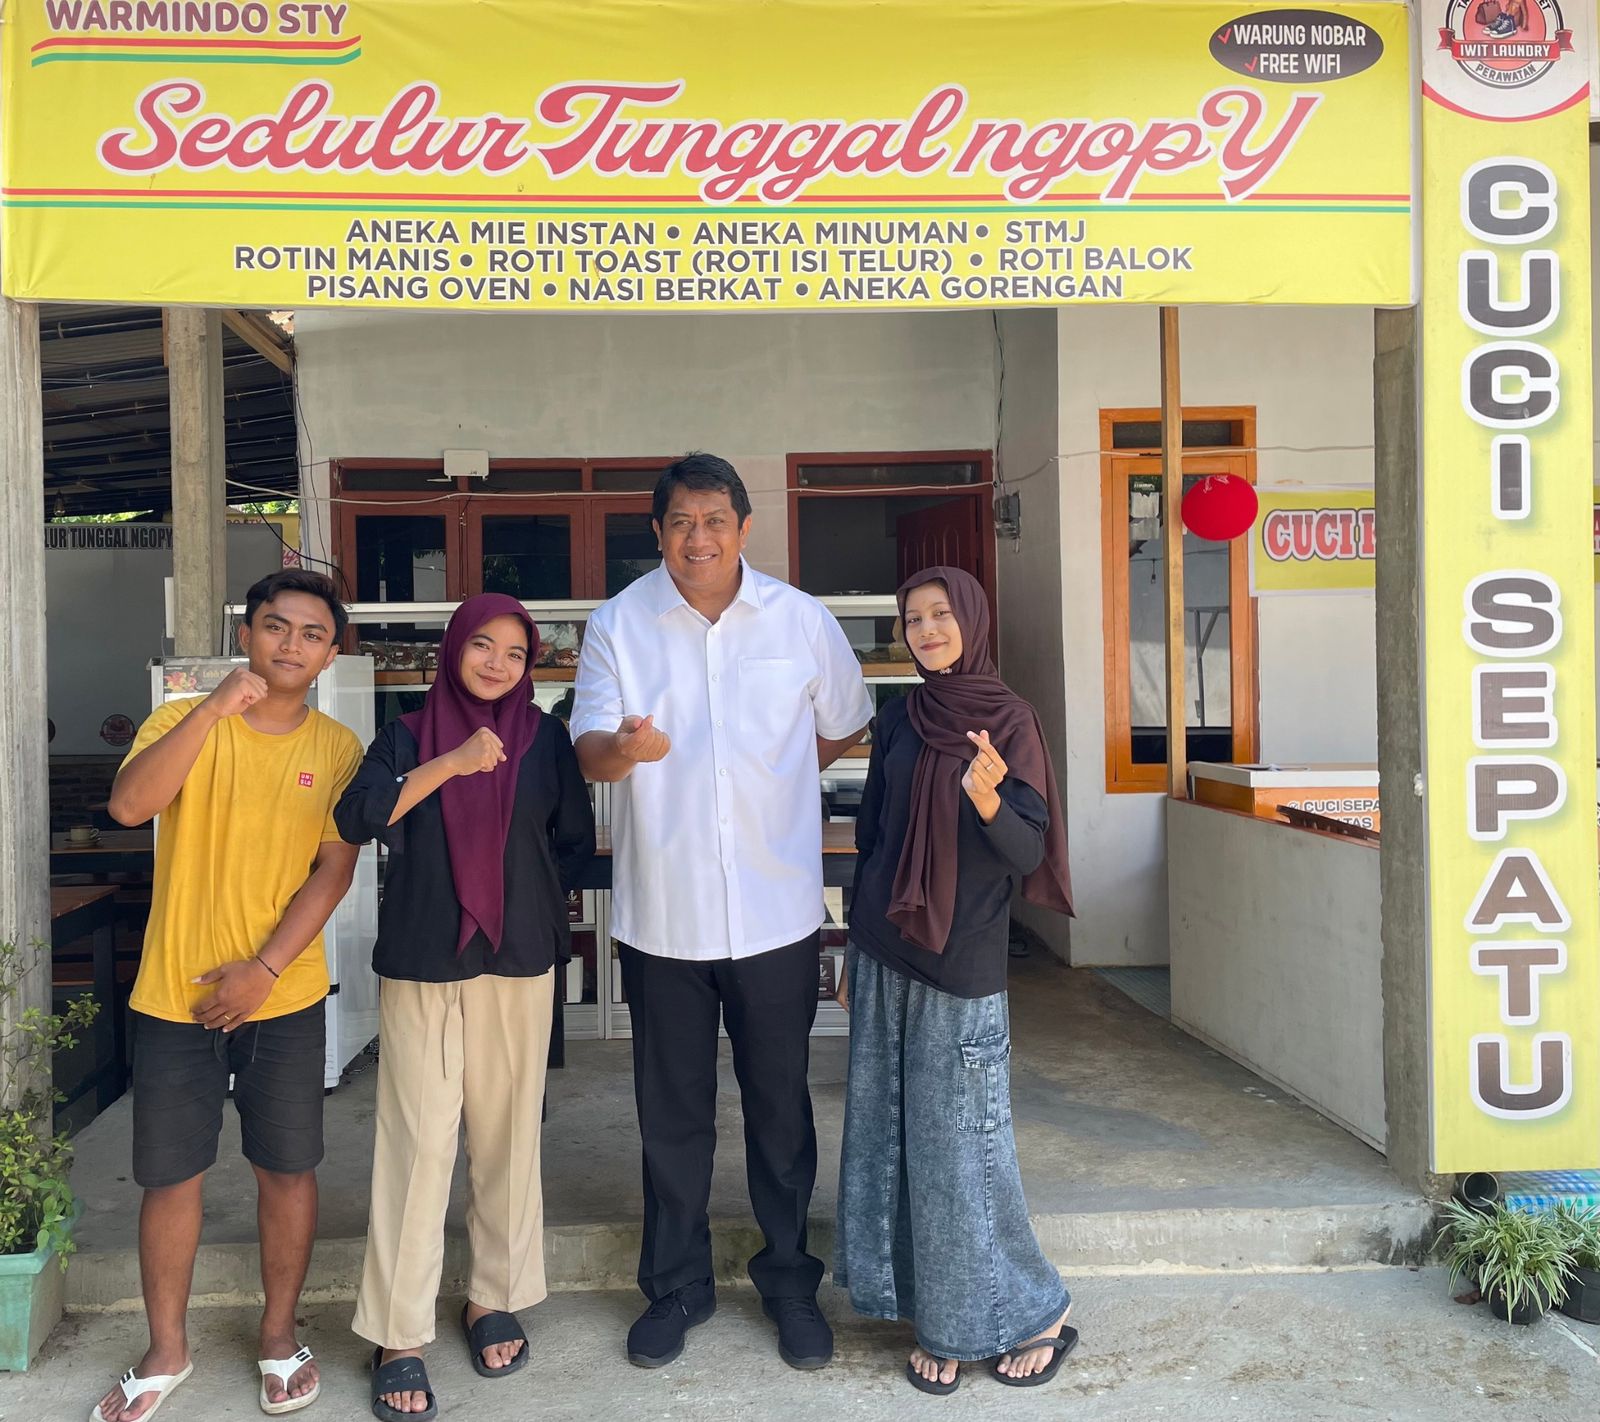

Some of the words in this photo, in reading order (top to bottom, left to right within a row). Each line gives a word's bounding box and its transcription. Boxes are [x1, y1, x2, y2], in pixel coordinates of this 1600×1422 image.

[45, 0, 270, 33] WARMINDO
[278, 3, 348, 35] STY
[1233, 24, 1306, 46] WARUNG
[1311, 25, 1367, 47] NOBAR
[1259, 53, 1299, 74] FREE
[1304, 53, 1341, 74] WIFI
[1460, 44, 1488, 57] IWIT
[1493, 44, 1551, 57] LAUNDRY
[1474, 63, 1537, 83] PERAWATAN
[99, 80, 525, 175] Sedulur
[528, 78, 965, 203] Tunggal
[346, 219, 460, 243] ANEKA
[471, 221, 526, 244] MIE
[537, 221, 655, 245] INSTAN
[693, 221, 805, 245] ANEKA
[815, 221, 968, 245] MINUMAN
[1005, 220, 1086, 243] STMJ
[234, 246, 336, 270] ROTIN
[349, 248, 451, 272] MANIS
[489, 249, 564, 273] ROTI
[574, 250, 682, 273] TOAST
[691, 249, 779, 277] (ROTI
[791, 249, 827, 273] ISI
[838, 249, 953, 276] TELUR)
[999, 248, 1073, 271] ROTI
[1084, 247, 1193, 270] BALOK
[308, 276, 429, 299] PISANG
[439, 277, 530, 300] OVEN
[569, 278, 643, 301] NASI
[655, 278, 782, 301] BERKAT
[818, 277, 931, 300] ANEKA
[940, 275, 1122, 299] GORENGAN
[1464, 161, 1555, 514] CUCI
[69, 527, 129, 549] TUNGGAL
[1265, 511, 1354, 560] CUCI
[1303, 801, 1340, 812] CUCI
[1467, 573, 1568, 1115] SEPATU
